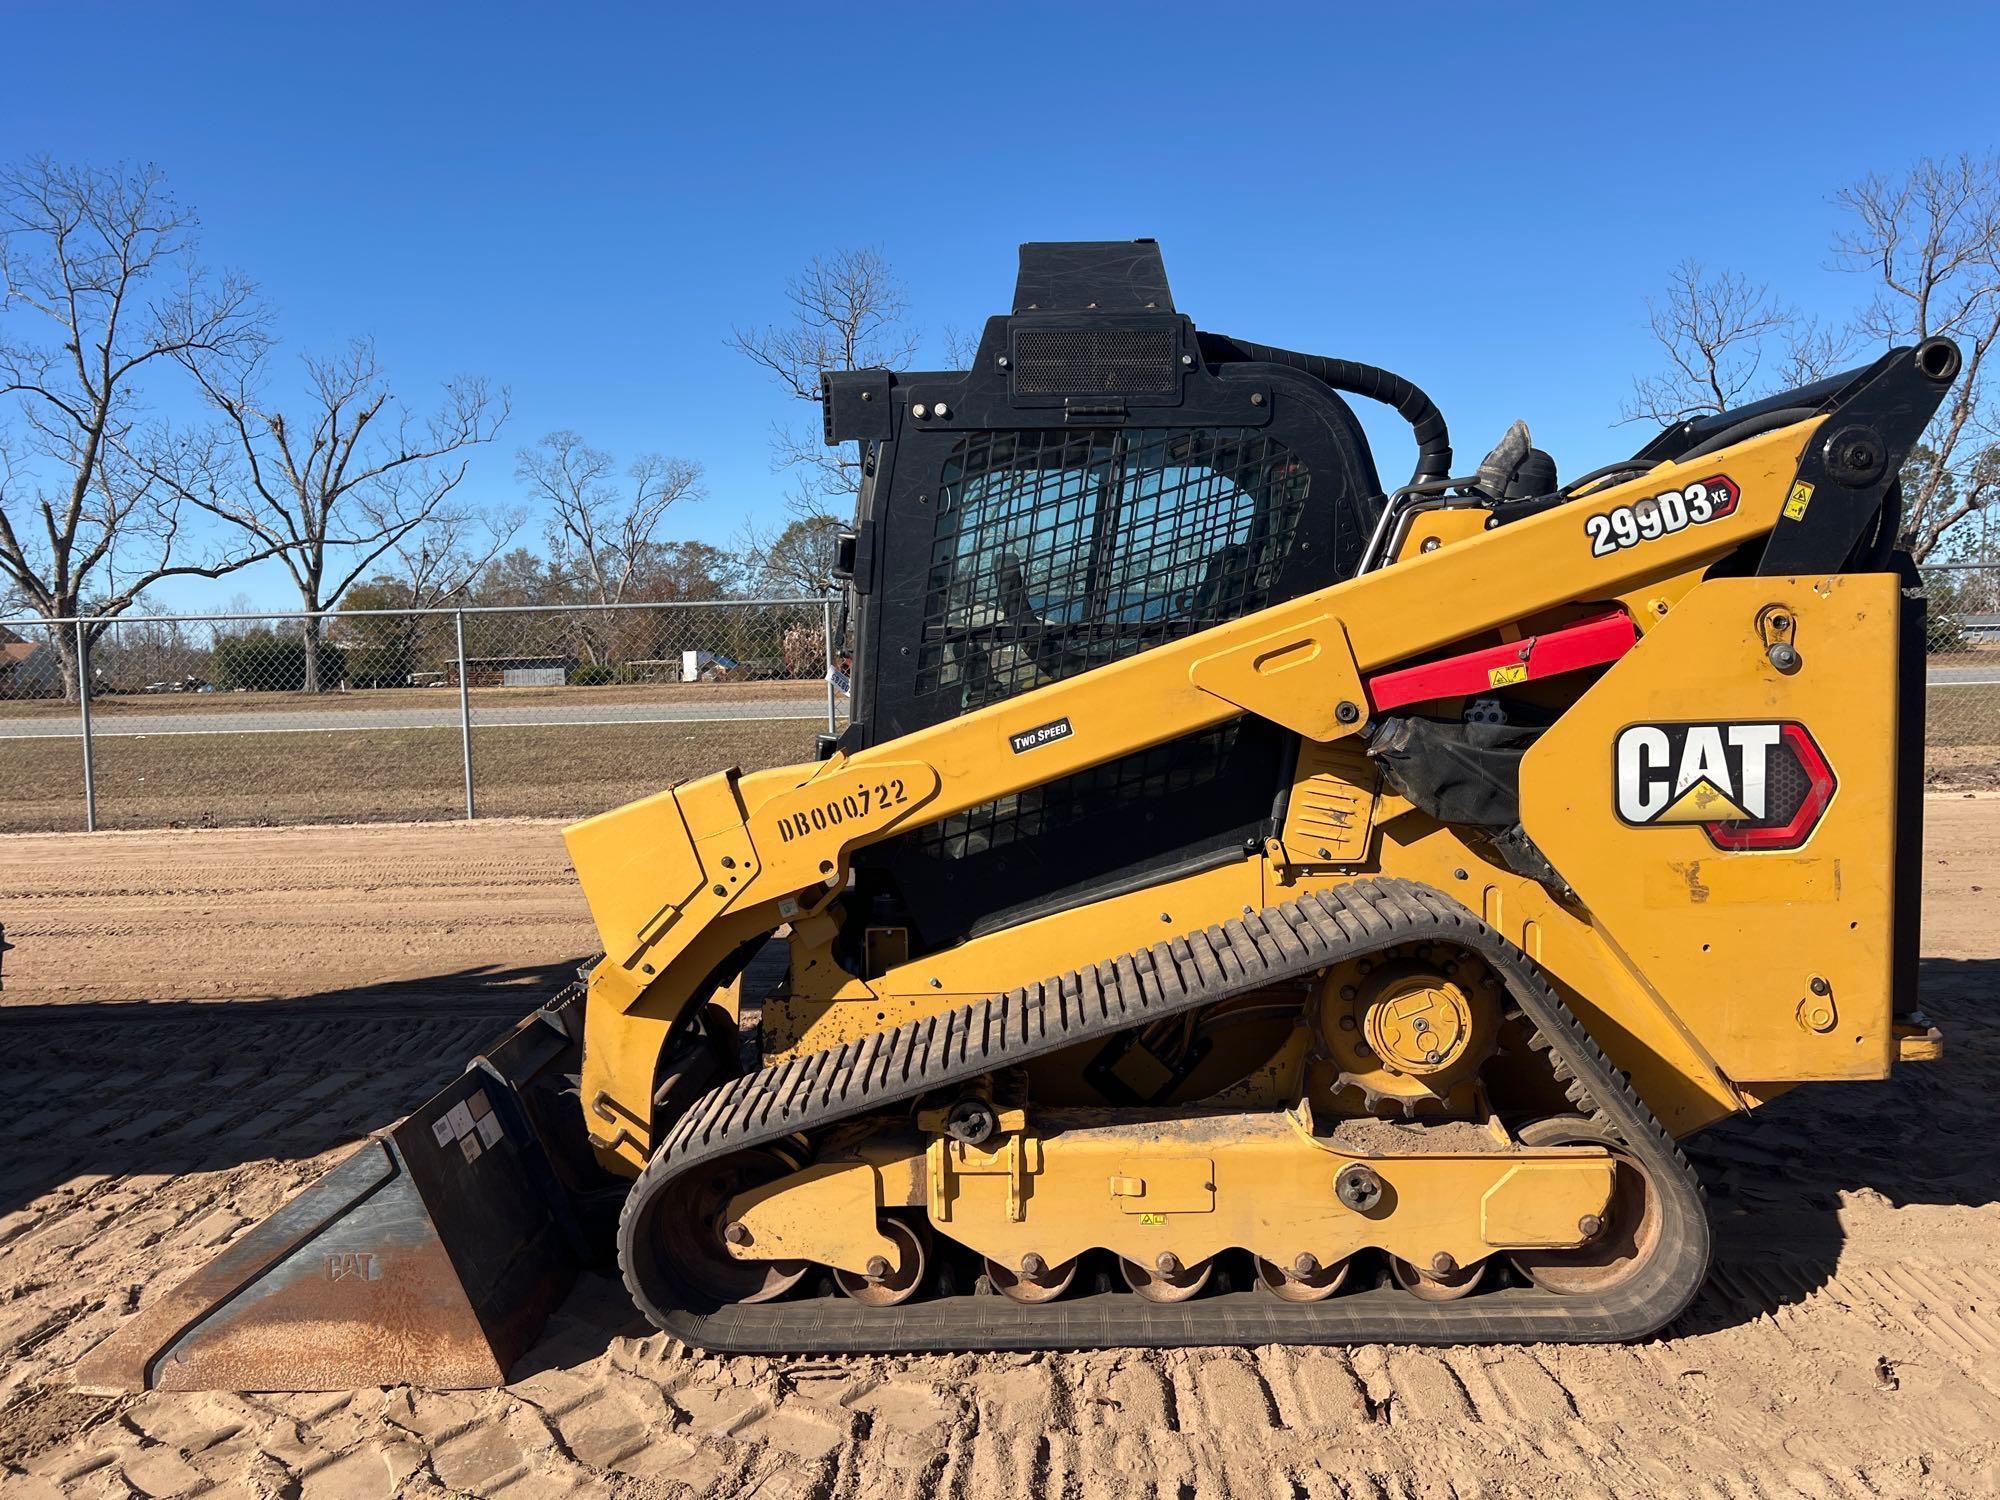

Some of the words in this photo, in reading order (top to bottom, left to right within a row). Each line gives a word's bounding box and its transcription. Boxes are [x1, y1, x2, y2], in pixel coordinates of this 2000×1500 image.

[1586, 484, 1713, 556] 299D3
[1711, 489, 1729, 505] XE
[1013, 734, 1036, 750] TWO
[1037, 723, 1067, 742] SPEED
[1618, 724, 1781, 823] CAT
[777, 779, 908, 843] DB000722
[323, 1252, 374, 1282] CAT
